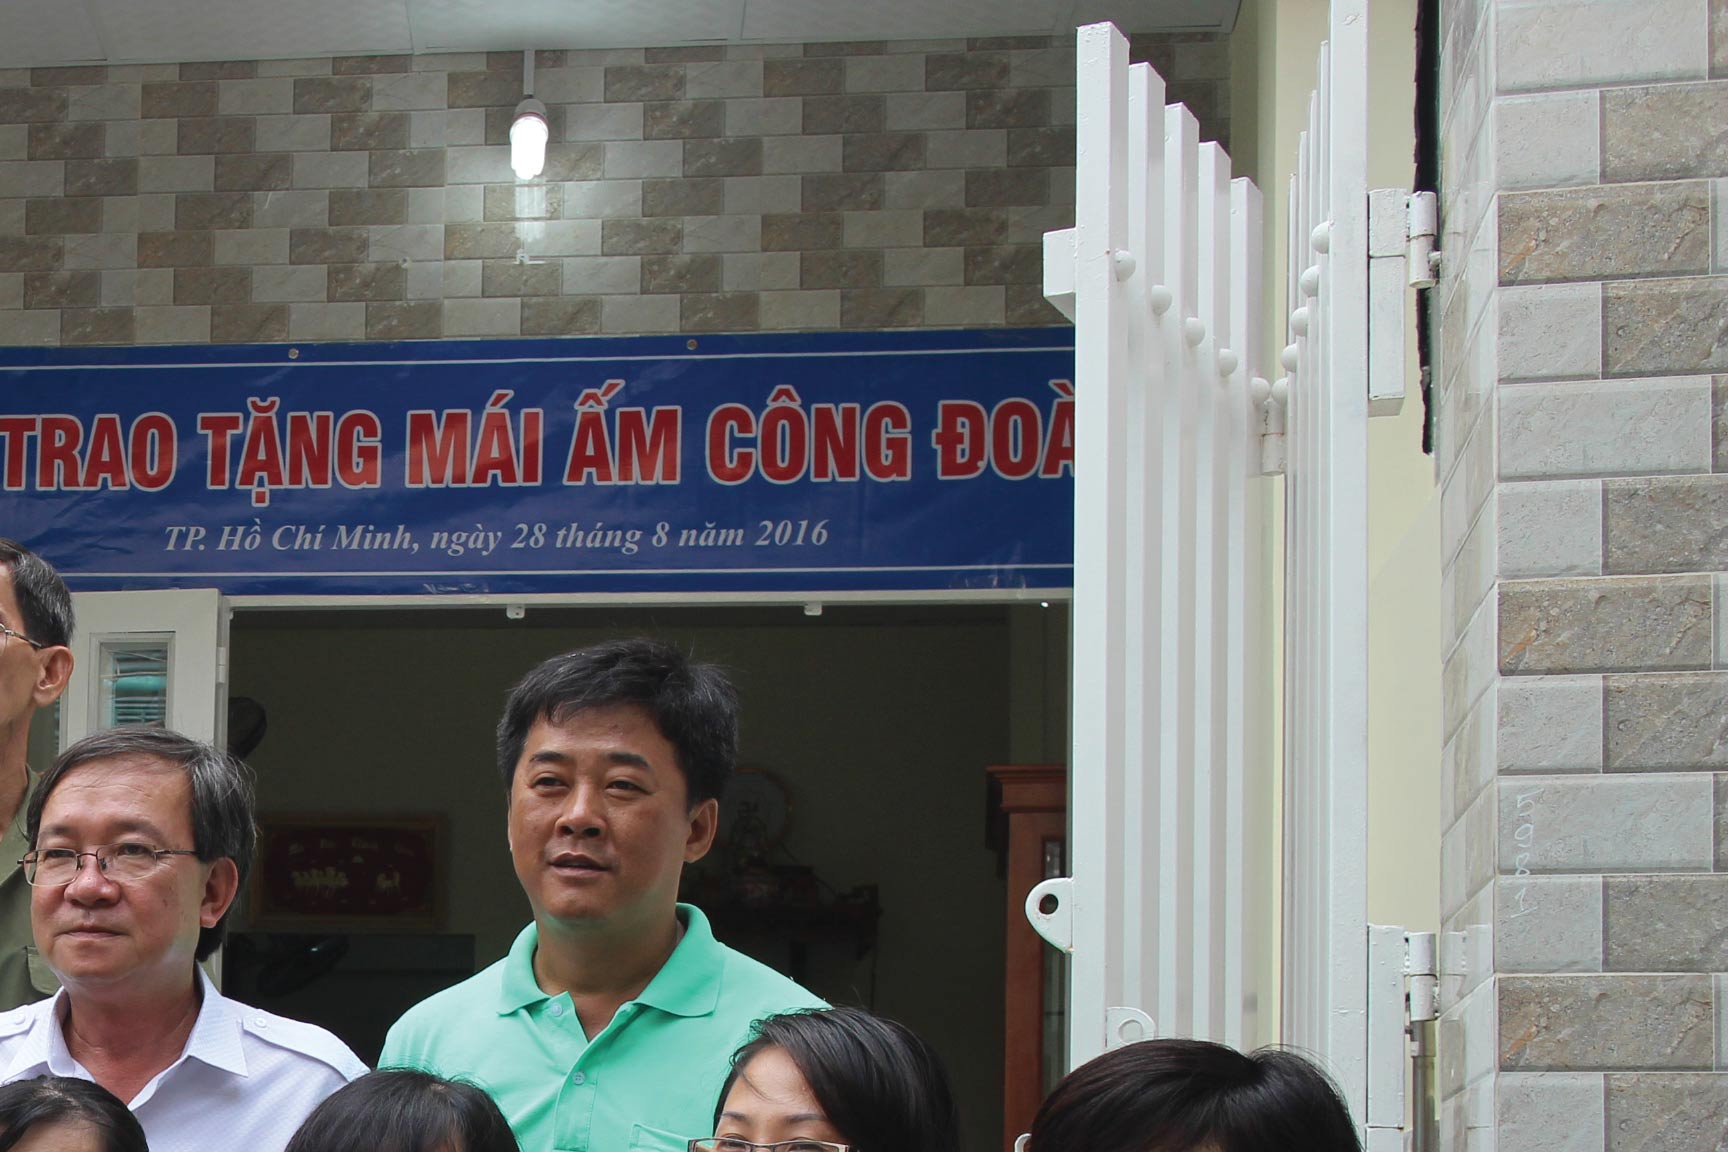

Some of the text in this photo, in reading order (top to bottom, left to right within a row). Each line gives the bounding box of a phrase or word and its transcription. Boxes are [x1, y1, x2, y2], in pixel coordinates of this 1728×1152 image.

[198, 396, 382, 508] TẶNG
[405, 388, 545, 489] MÁI
[563, 379, 682, 487] ẤM
[706, 384, 912, 486] CÔNG
[165, 518, 831, 557] TP. Hồ Chí Minh, ngày 28 tháng 8 năm 2016
